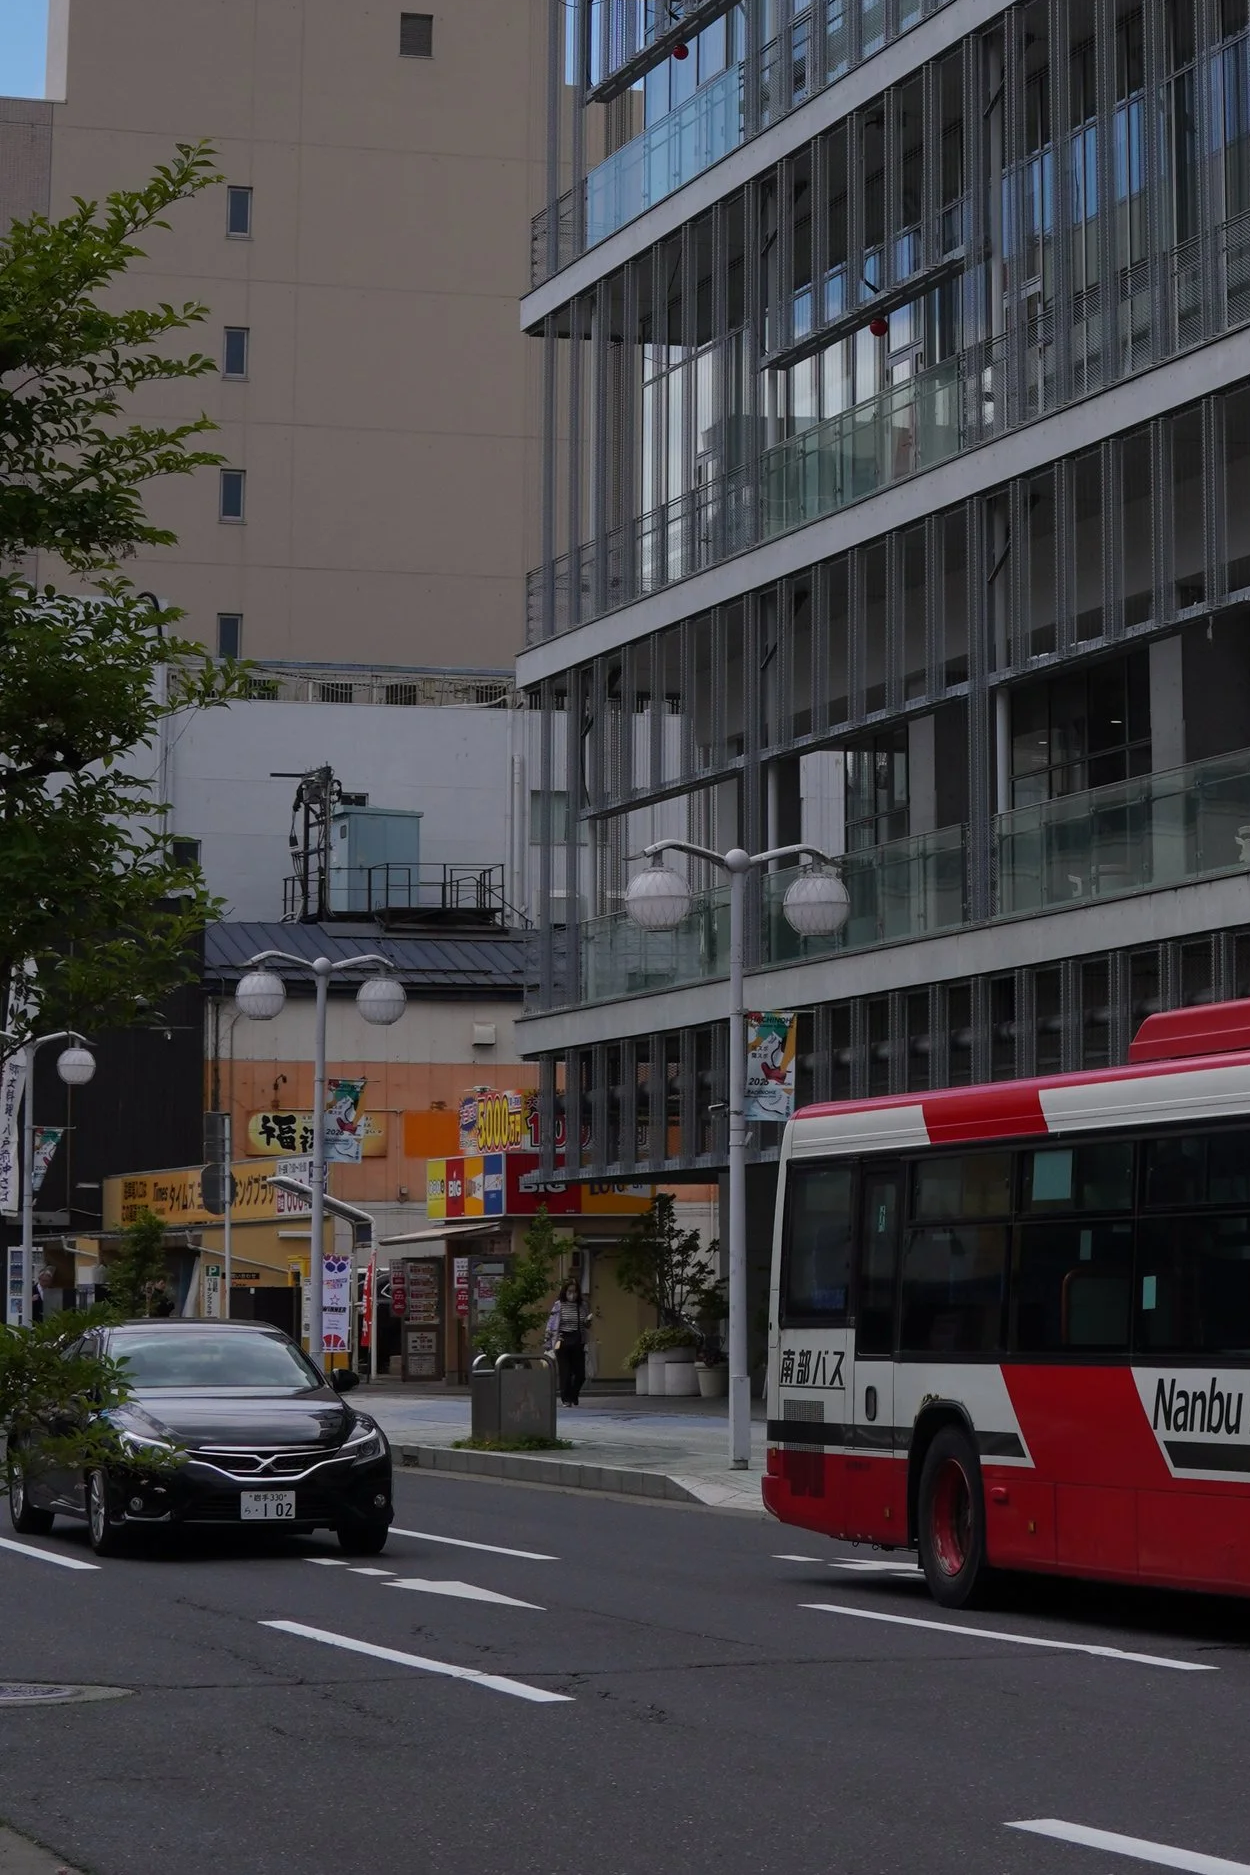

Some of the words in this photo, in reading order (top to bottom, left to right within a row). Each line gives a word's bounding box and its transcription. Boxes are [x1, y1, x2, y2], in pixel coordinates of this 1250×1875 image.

[169, 1181, 195, 1211] タイムズ
[448, 1179, 462, 1197] BIG
[780, 1348, 845, 1386] 南部バス
[1152, 1375, 1243, 1435] Nanbu
